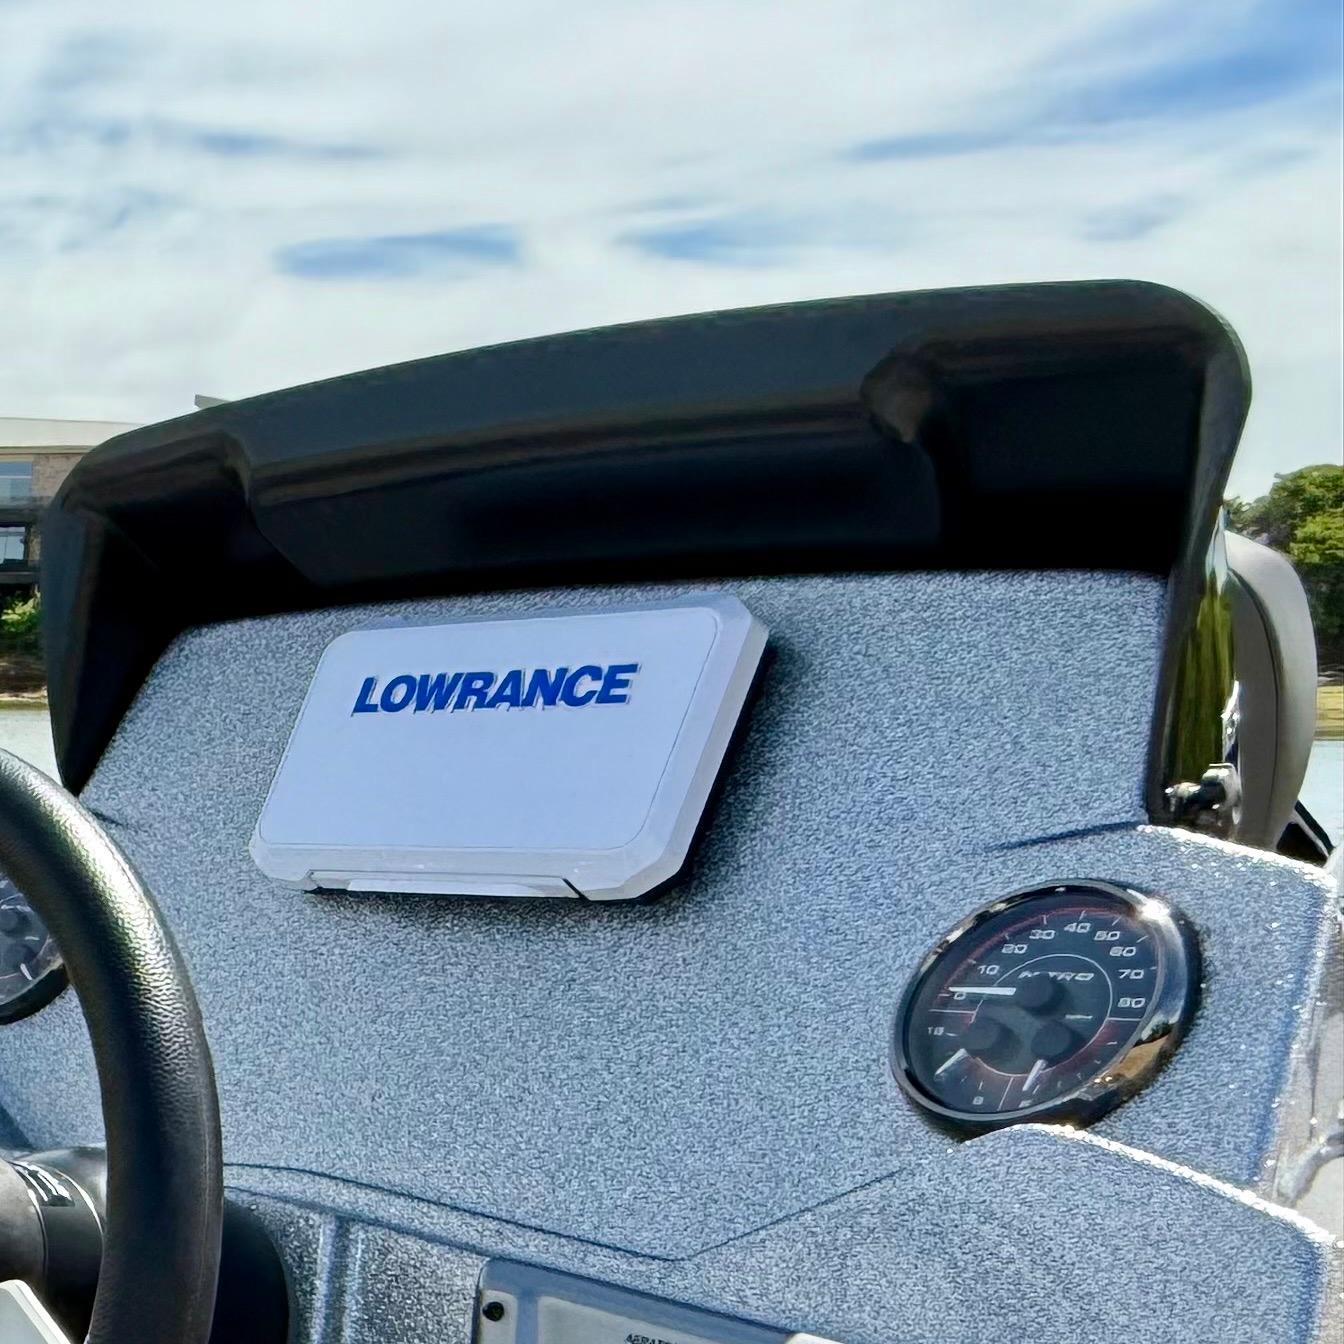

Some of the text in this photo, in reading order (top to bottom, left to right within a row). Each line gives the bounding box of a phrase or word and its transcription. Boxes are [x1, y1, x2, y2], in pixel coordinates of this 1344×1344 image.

[351, 662, 640, 716] LOWRANCE
[1063, 922, 1092, 933] 40
[1029, 929, 1056, 940] 30
[977, 964, 1000, 975] 10
[1117, 969, 1145, 980] 70
